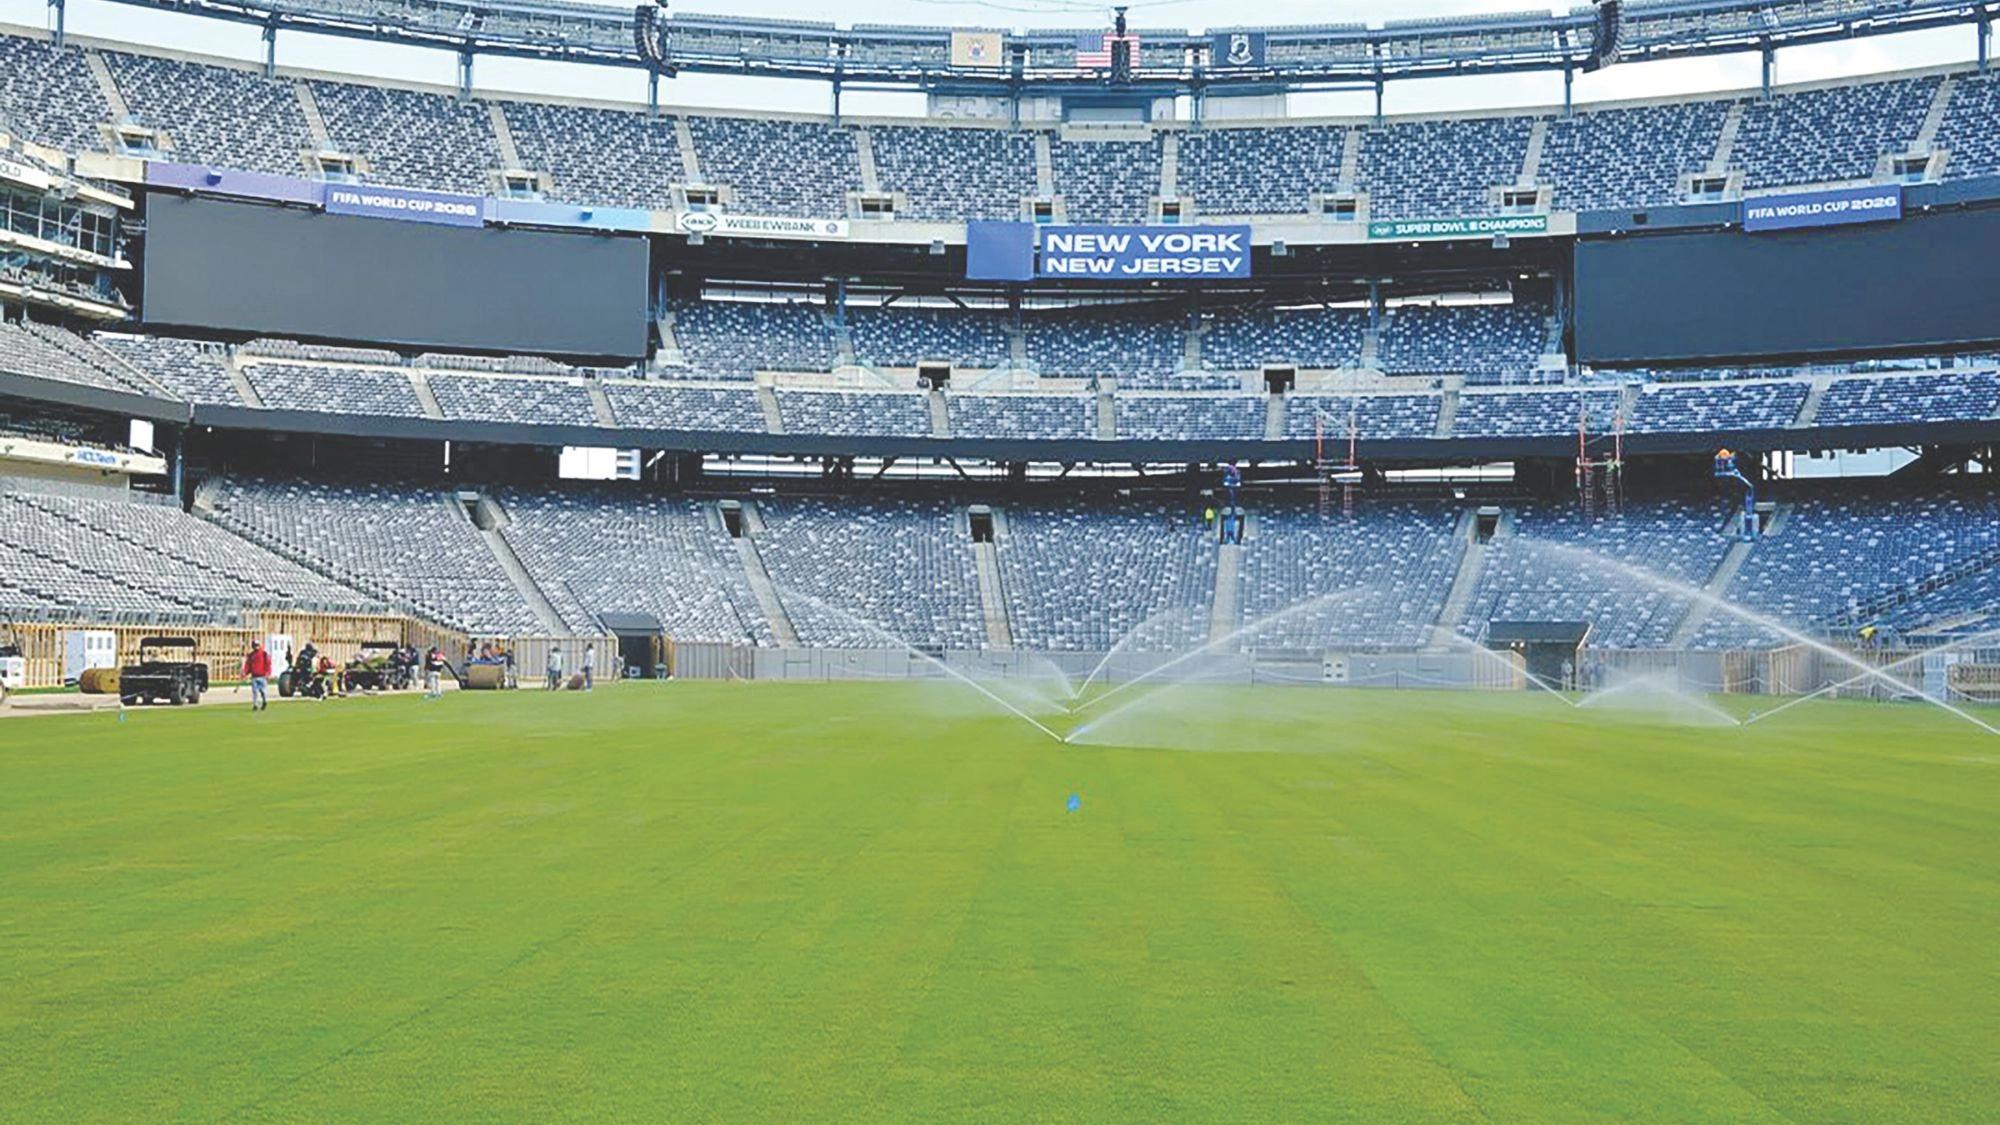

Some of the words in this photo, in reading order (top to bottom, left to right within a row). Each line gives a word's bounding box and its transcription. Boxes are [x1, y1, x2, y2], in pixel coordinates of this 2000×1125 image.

[332, 192, 361, 205] FIFA
[361, 196, 407, 209] WORLD
[408, 200, 433, 212] CUP
[434, 202, 477, 216] 2026
[1748, 207, 1775, 219] FIFA
[1776, 203, 1820, 217] WORLD
[1823, 200, 1850, 213] CUP
[1851, 196, 1897, 210] 2026
[1395, 223, 1431, 235] SUPER
[1432, 222, 1467, 233] BOWL
[1479, 218, 1545, 231] CHAMPIONS
[1047, 234, 1130, 253] NEW
[1138, 233, 1242, 253] YORK
[1046, 257, 1116, 273] NEW
[1121, 257, 1242, 274] JERSEY
